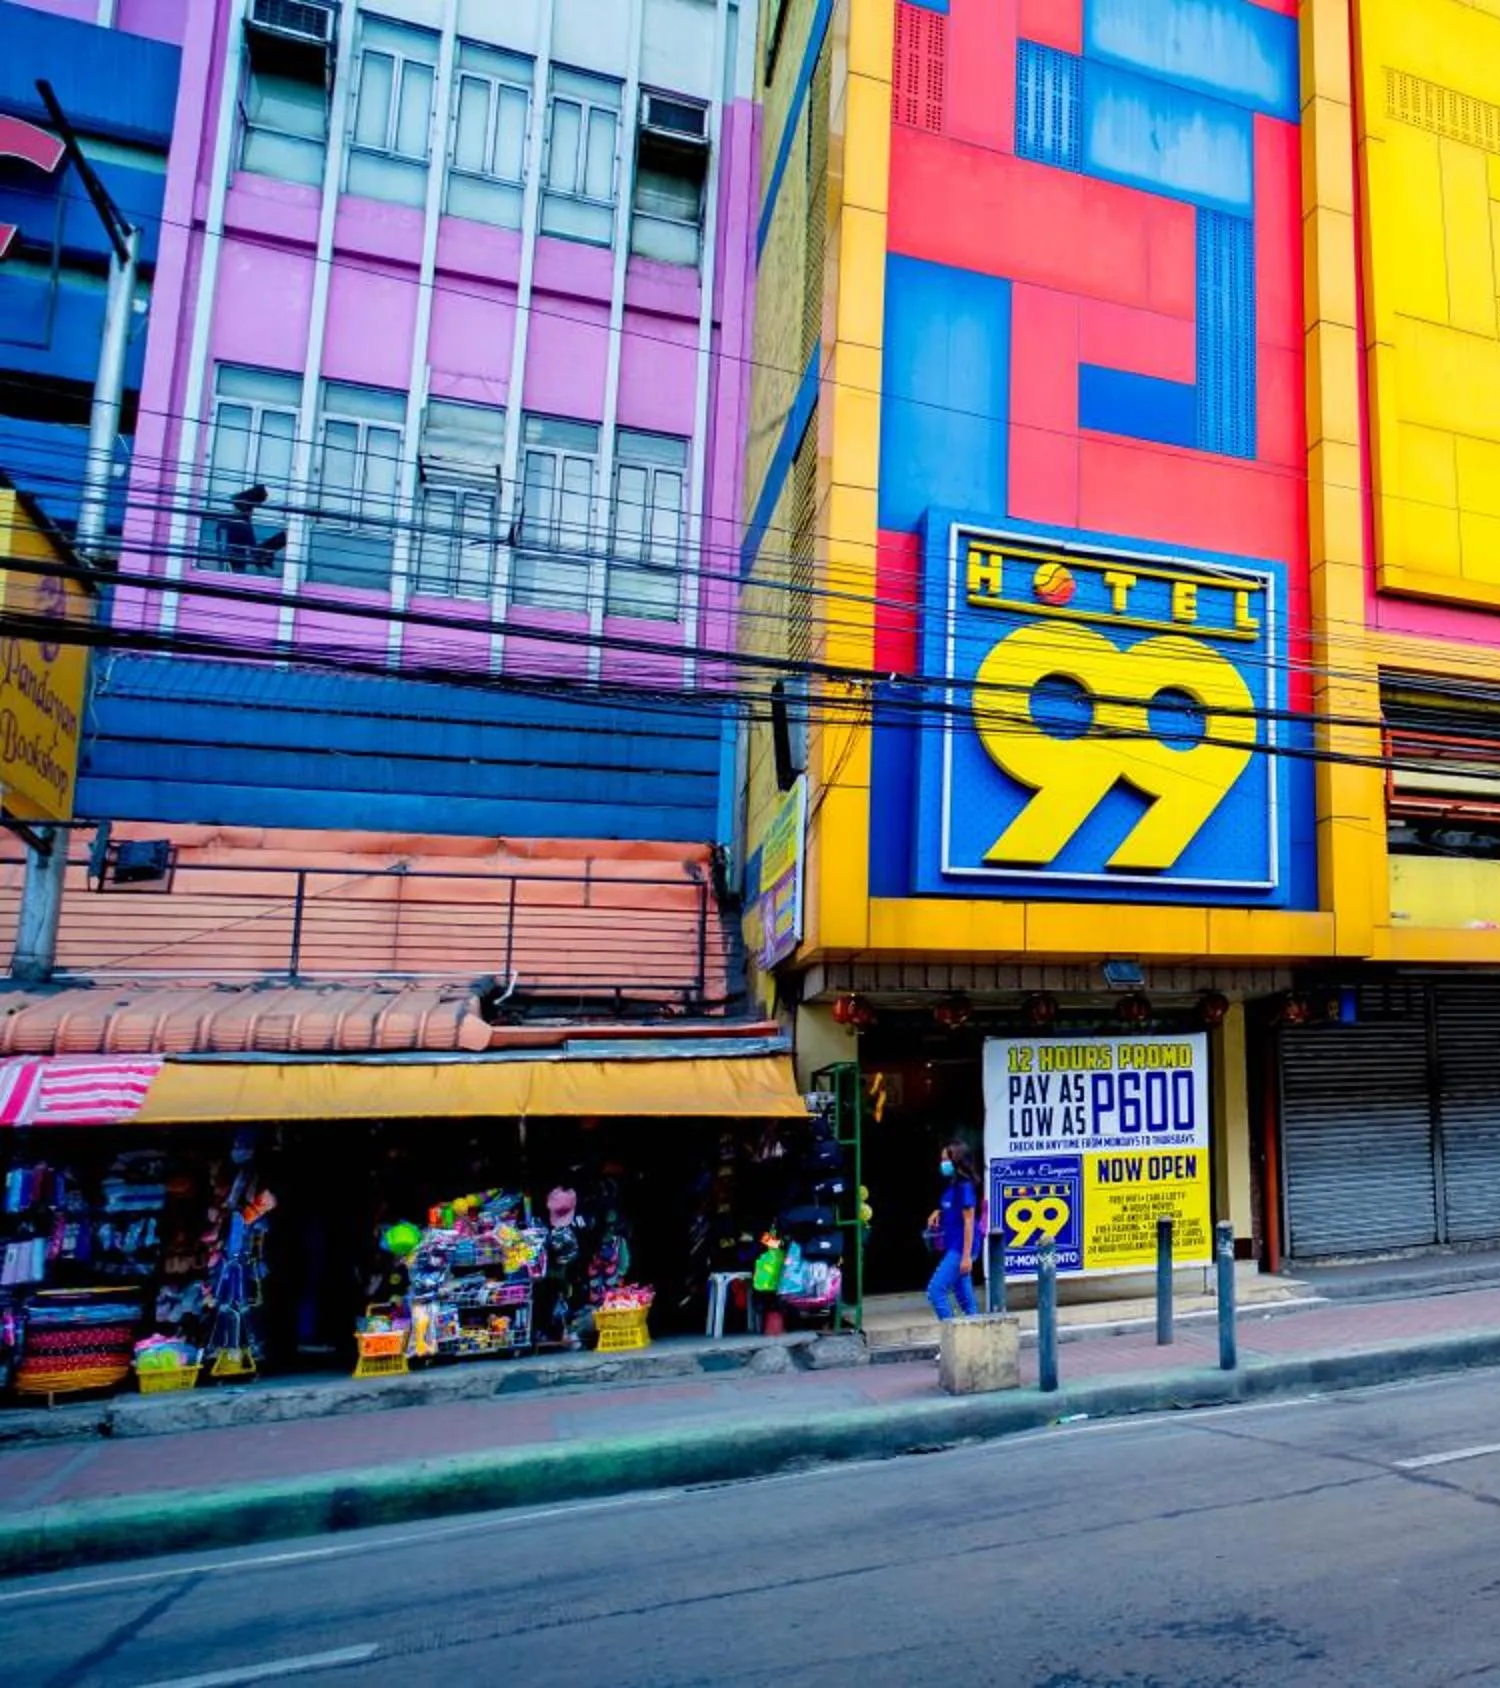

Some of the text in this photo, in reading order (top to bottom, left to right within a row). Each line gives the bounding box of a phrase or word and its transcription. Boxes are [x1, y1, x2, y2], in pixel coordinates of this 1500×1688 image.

[967, 551, 1260, 630] HOTEL
[0, 709, 69, 806] Bookshop
[973, 620, 1257, 869] 99
[1008, 1043, 1192, 1072] 12 HOURS PROMO
[1008, 1070, 1195, 1135] PAY AS P600
[1008, 1106, 1086, 1138] LOW AS
[1097, 1155, 1197, 1184] NOW OPEN
[1005, 1197, 1071, 1248] 99
